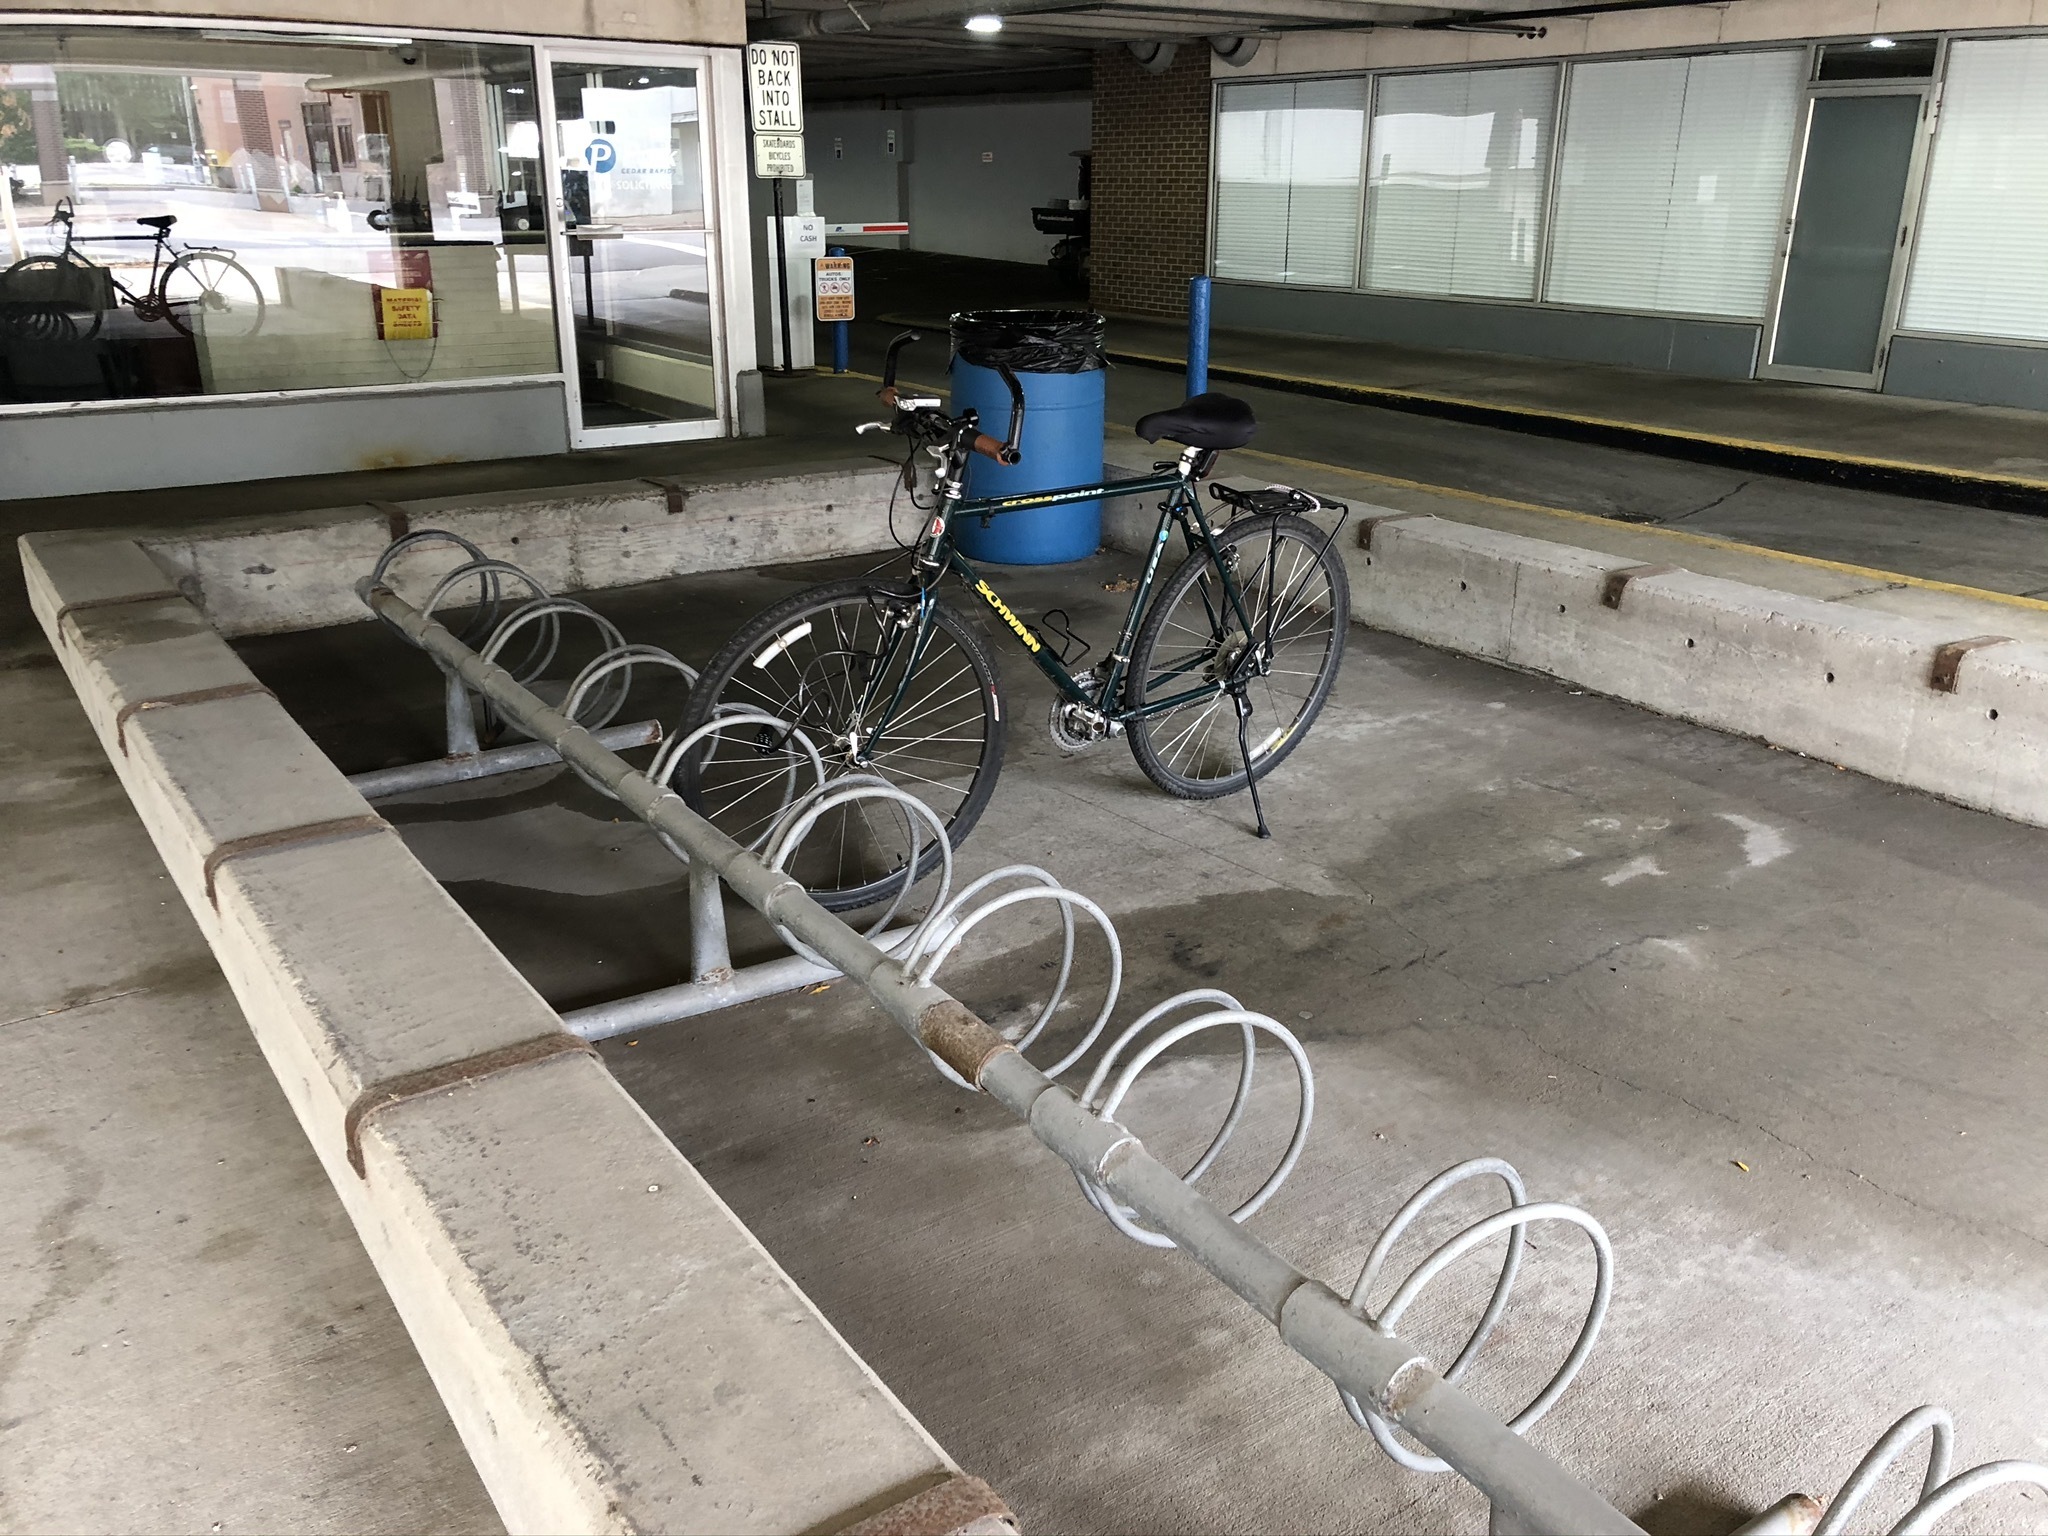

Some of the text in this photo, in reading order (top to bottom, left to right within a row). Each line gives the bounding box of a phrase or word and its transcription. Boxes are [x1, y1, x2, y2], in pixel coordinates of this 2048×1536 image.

[751, 49, 795, 66] DO NOT
[758, 70, 791, 86] BACK
[762, 90, 790, 106] INTO
[759, 110, 796, 126] STALL
[762, 139, 796, 149] SKATEBOARDS
[768, 151, 791, 161] BICYCLES
[766, 163, 795, 173] PROHIBITED
[1001, 488, 1105, 507] crosspoint
[974, 579, 1042, 653] SCHWINN
